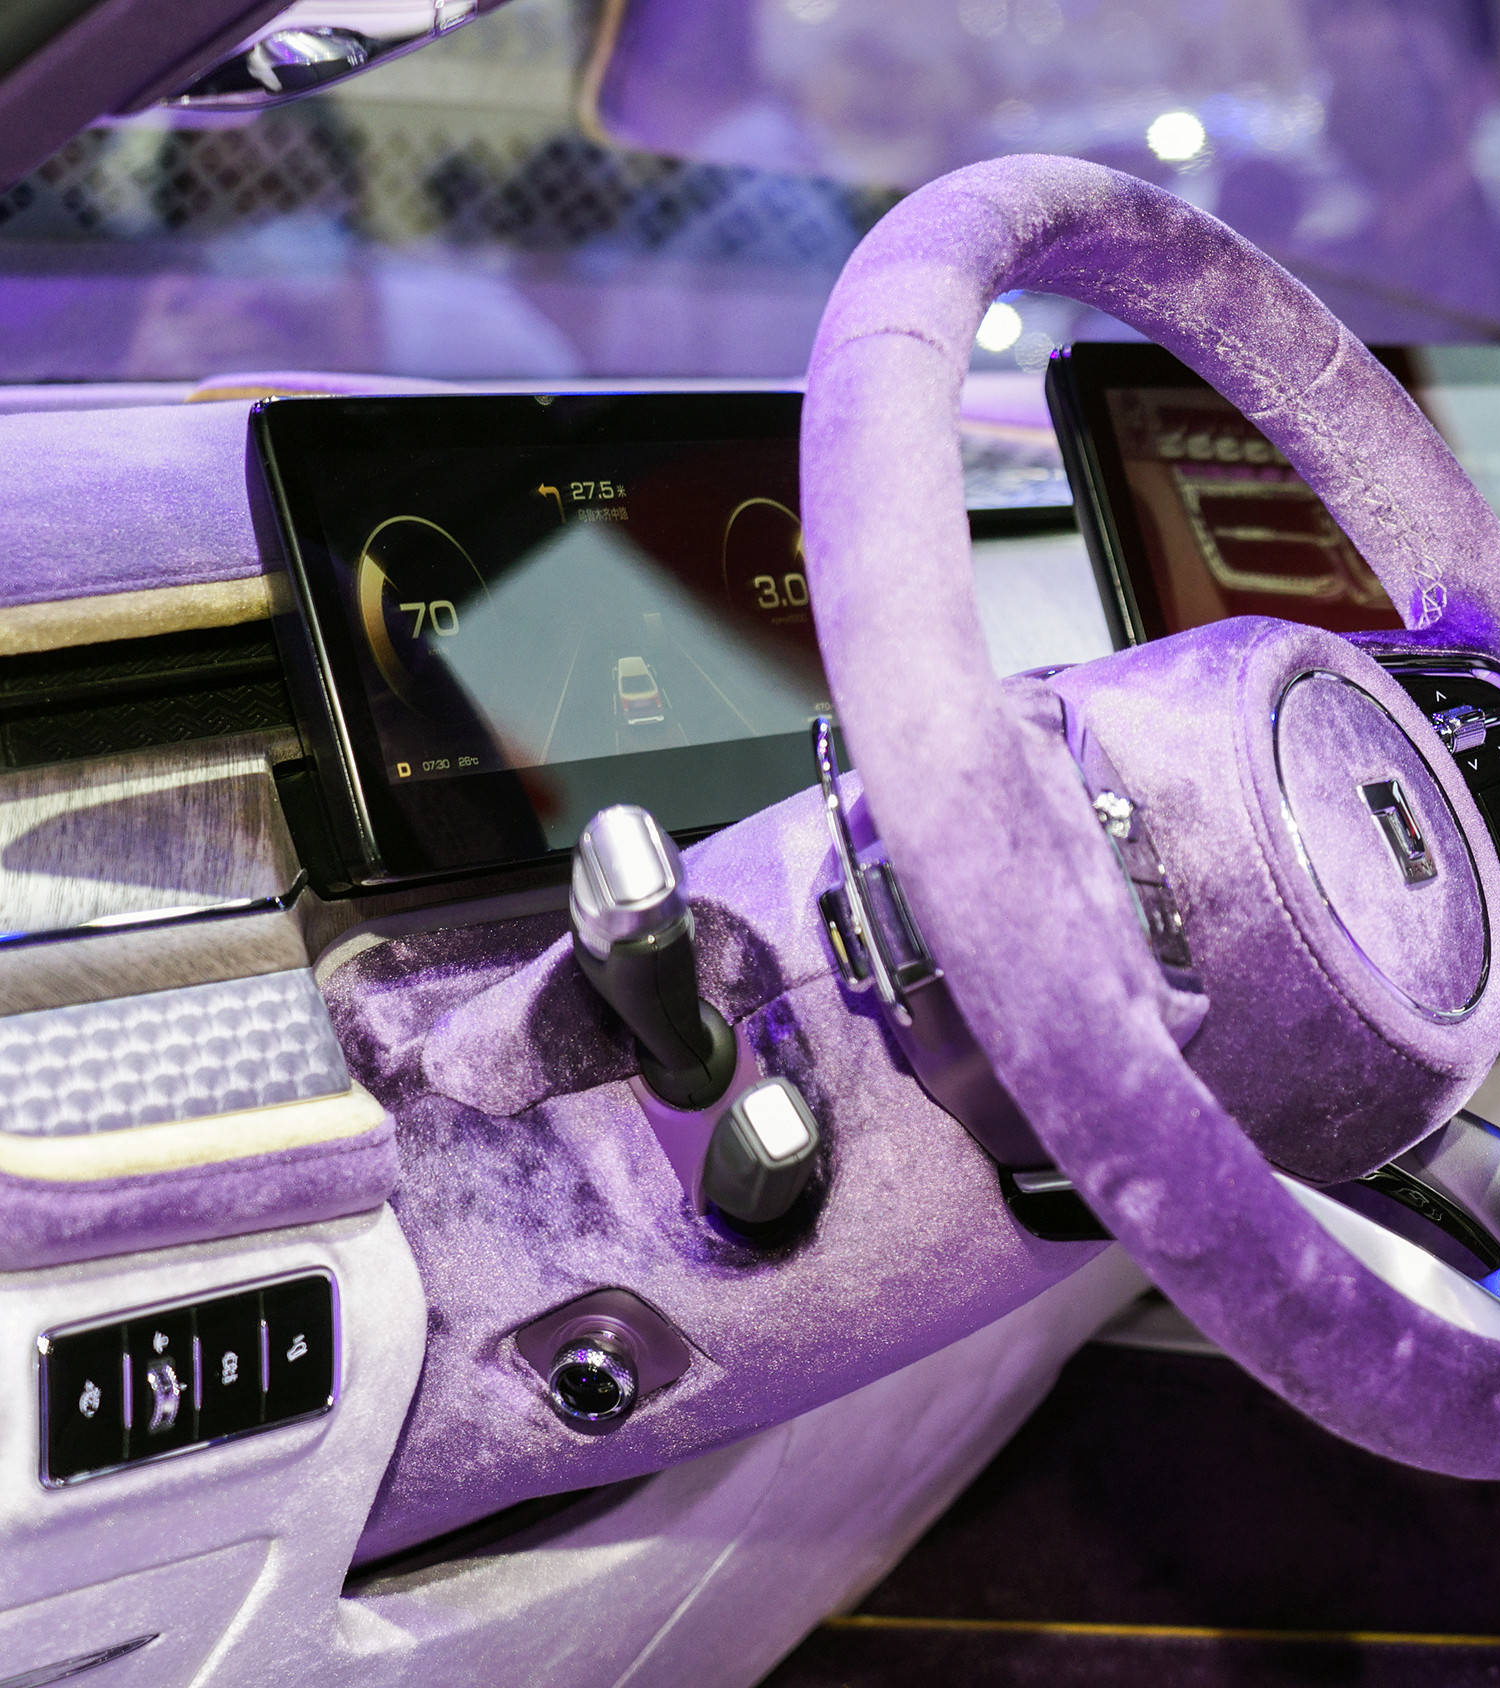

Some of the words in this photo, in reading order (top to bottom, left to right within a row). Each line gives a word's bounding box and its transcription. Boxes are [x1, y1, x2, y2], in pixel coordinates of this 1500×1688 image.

[570, 481, 614, 500] 27.5
[754, 573, 809, 609] 3.0
[399, 600, 459, 639] 70
[397, 762, 411, 778] D
